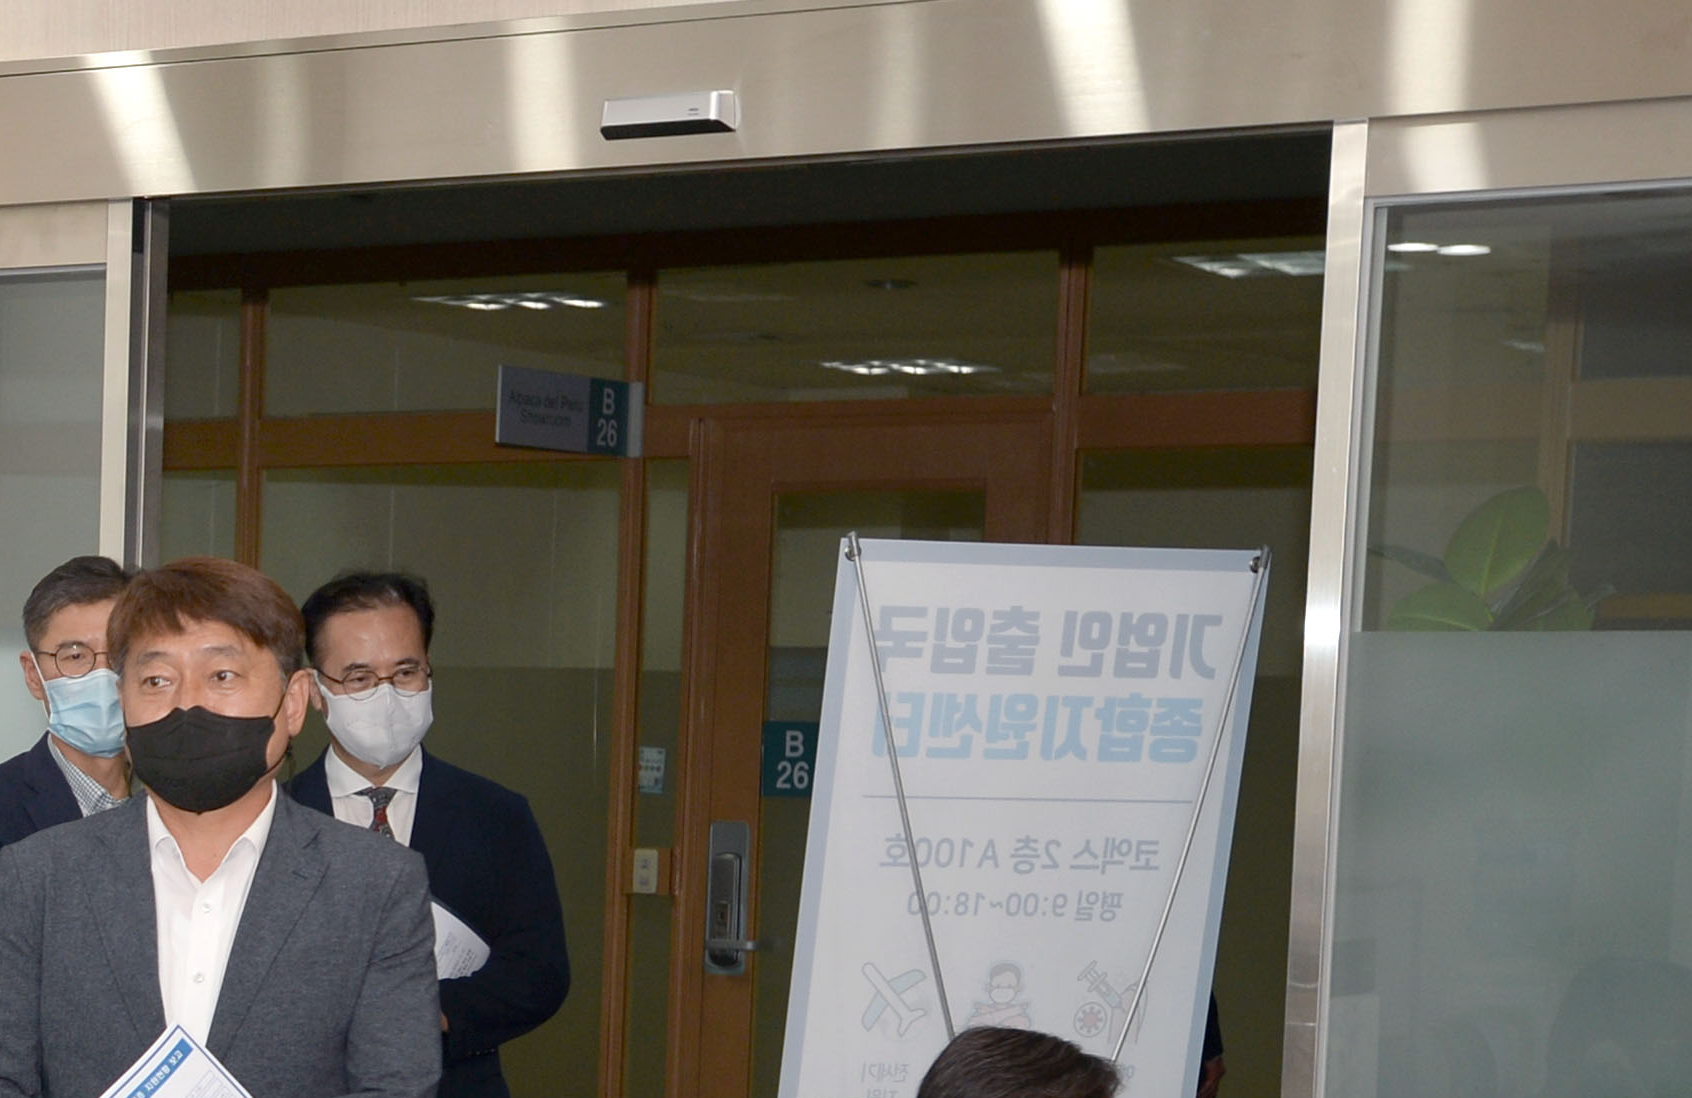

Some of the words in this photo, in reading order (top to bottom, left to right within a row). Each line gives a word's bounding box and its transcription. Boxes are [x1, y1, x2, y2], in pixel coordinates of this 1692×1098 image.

[602, 388, 615, 415] B
[596, 419, 618, 447] 26
[785, 730, 804, 757] B
[776, 761, 809, 789] 26
[169, 1049, 184, 1066] 보고
